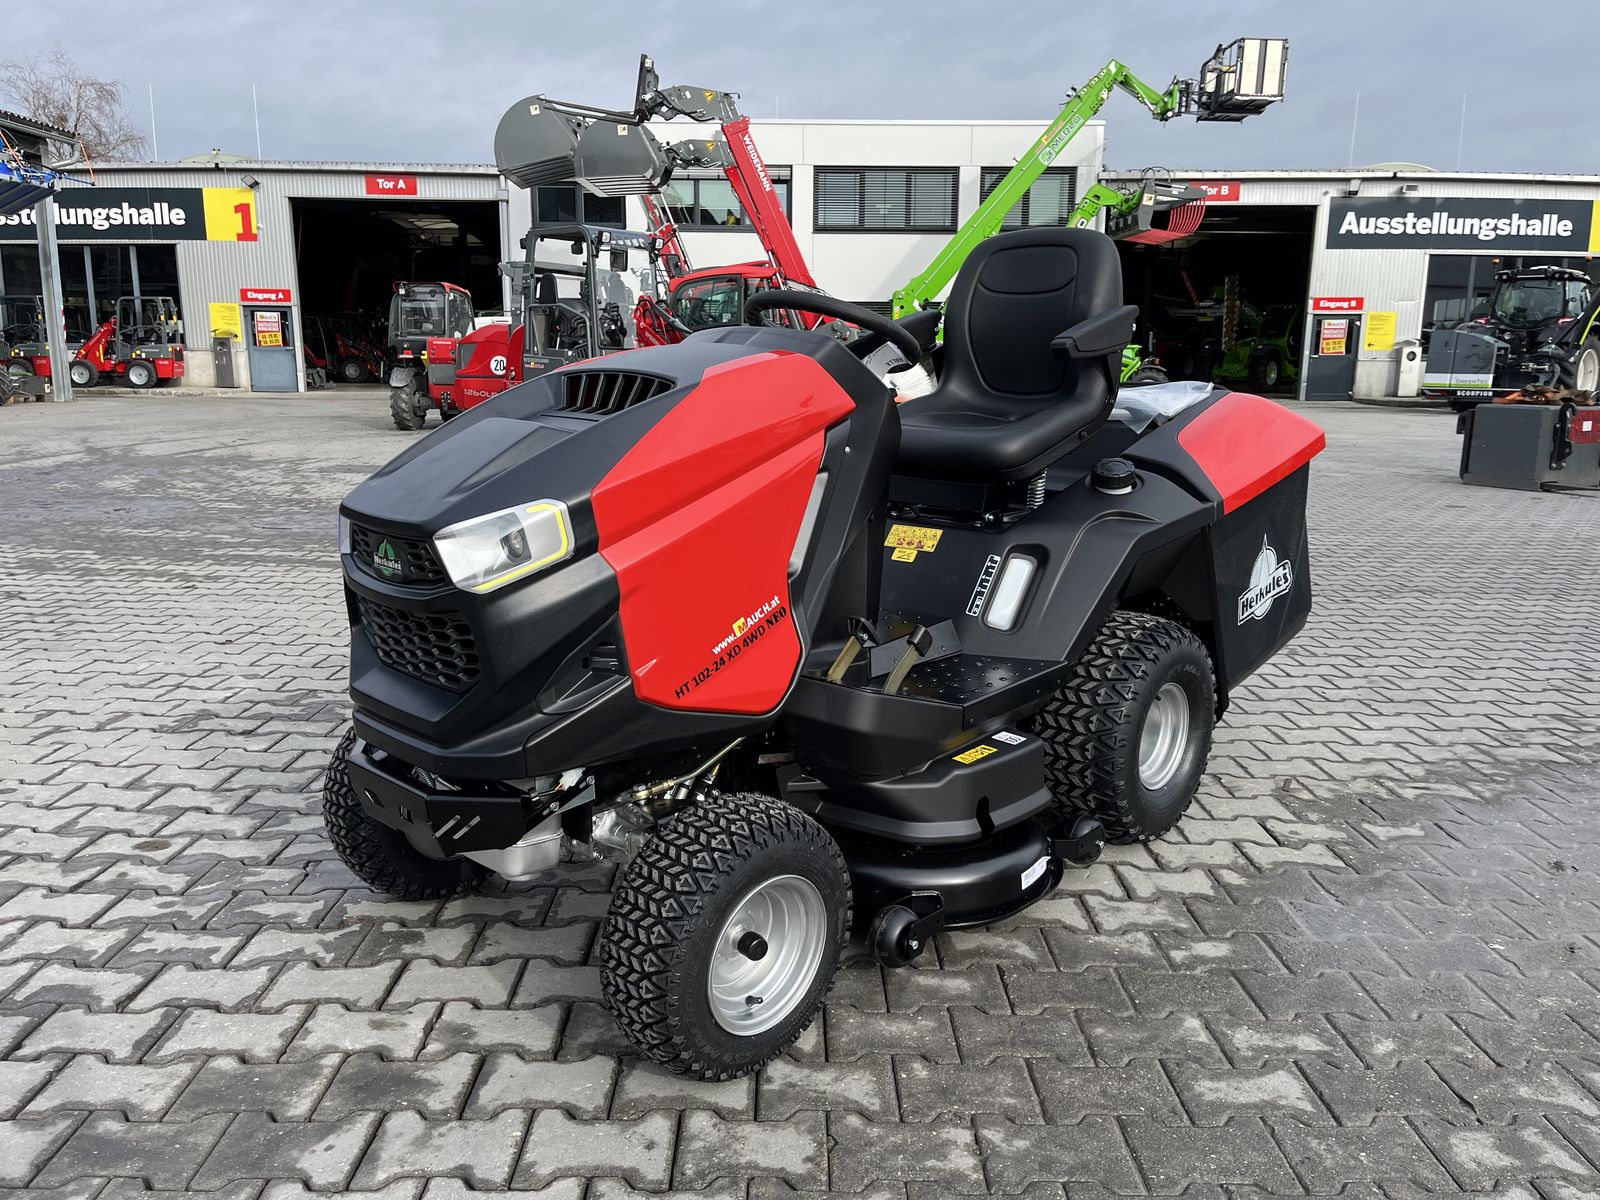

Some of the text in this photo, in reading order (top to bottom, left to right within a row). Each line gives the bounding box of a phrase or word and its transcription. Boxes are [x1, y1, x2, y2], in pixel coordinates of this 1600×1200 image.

[1050, 115, 1081, 149] MERLO
[743, 133, 772, 192] WEIDEMANN
[376, 179, 406, 189] Tor A
[1200, 185, 1230, 196] Tor B
[0, 203, 258, 241] stlungshalle 1
[1338, 211, 1574, 241] Ausstellungshalle
[247, 291, 284, 300] Eingang A
[1319, 300, 1349, 309] Eingang
[494, 359, 505, 372] 20
[1241, 562, 1290, 617] Herkules
[711, 594, 781, 655] www.MAUCH.at
[674, 605, 787, 699] HT 102-24 XD 4WD NEO
